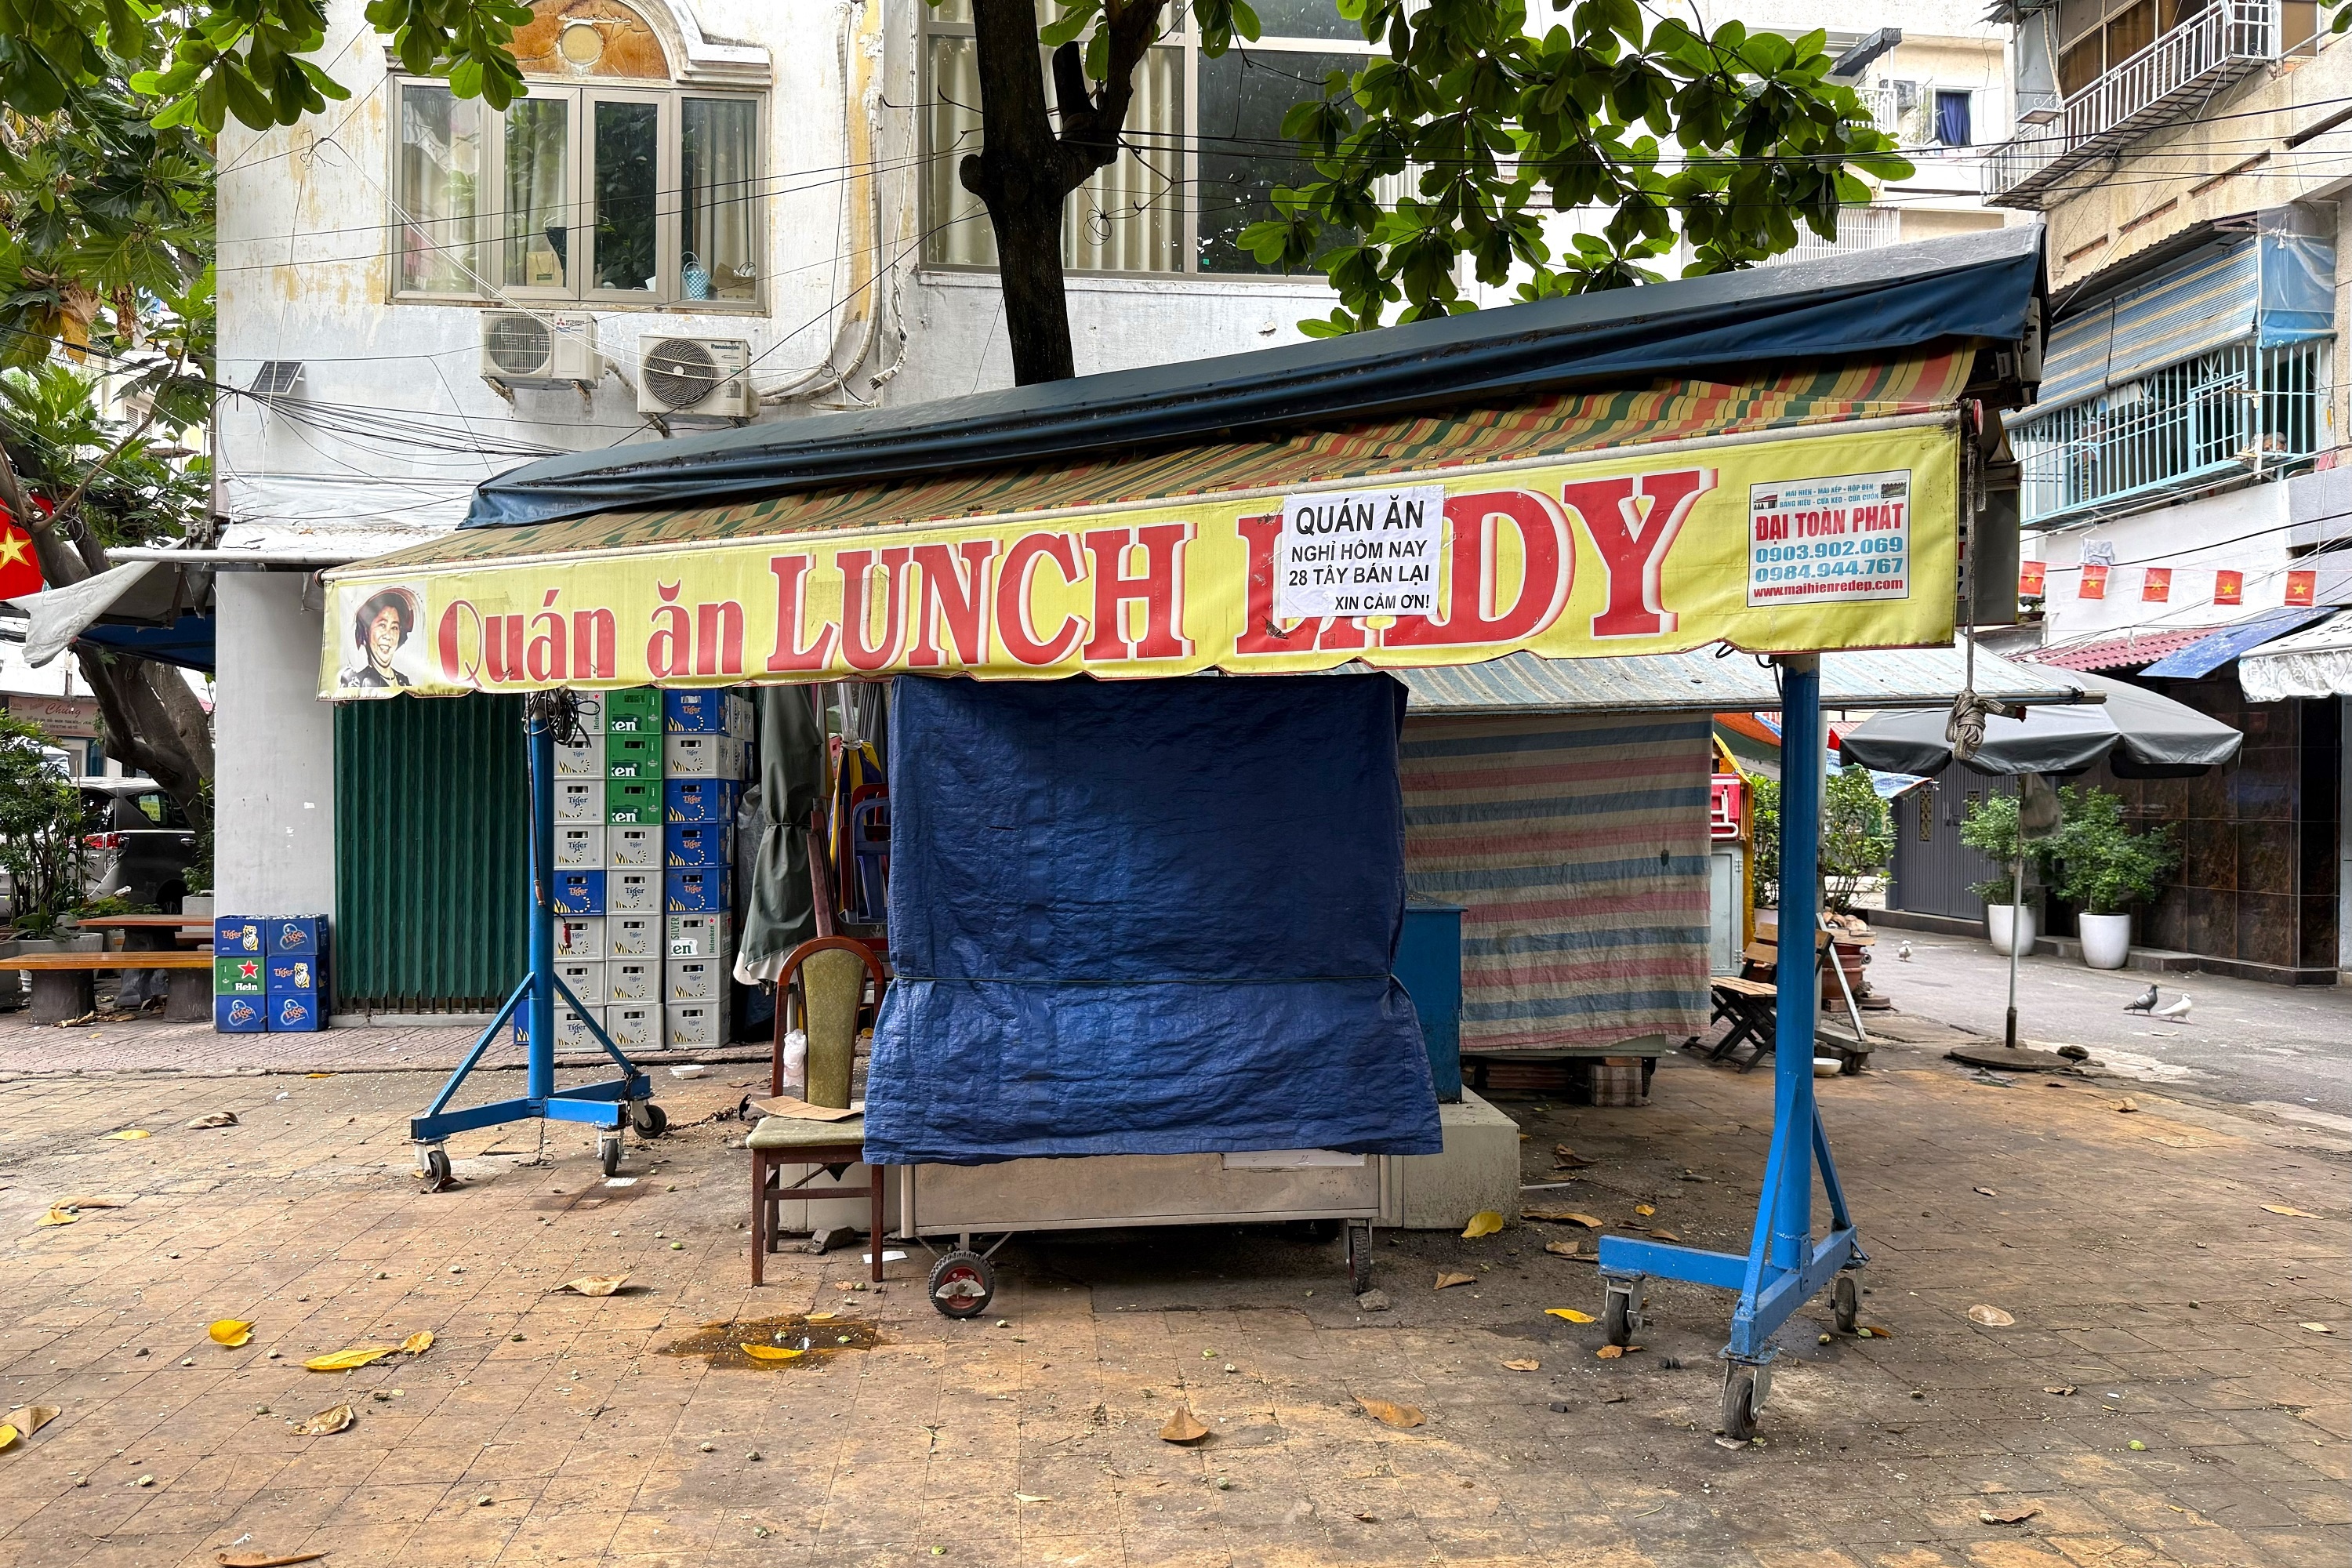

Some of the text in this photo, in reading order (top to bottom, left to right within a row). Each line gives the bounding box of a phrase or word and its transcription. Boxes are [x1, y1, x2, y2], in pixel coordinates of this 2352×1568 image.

[1296, 495, 1424, 536] QUÁN ĂN
[1755, 500, 1904, 545] ĐẠI TOÀN PHÁT
[1291, 539, 1428, 562] NGHỈ HÔM NAY
[1755, 536, 1903, 564] 0903.902.069
[1289, 563, 1429, 586] 28 TÂY BÁN LẠI
[1755, 557, 1904, 582] 0984.944.767
[437, 588, 618, 688] Quán
[646, 579, 745, 679] ăn
[765, 521, 1200, 672] LUNCH
[1233, 468, 1719, 656] LDY
[1754, 579, 1904, 597] www.maihienredep.com
[1335, 592, 1430, 610] XIN CẢM ƠN!
[682, 706, 702, 715] Tiger
[568, 796, 588, 808] Tiger
[683, 795, 702, 804] Tiger
[567, 840, 588, 853] Tiger
[683, 840, 702, 849] Tiger
[568, 887, 588, 897] Tiger
[625, 887, 644, 898] Tiger
[684, 884, 703, 894] Tiger
[671, 916, 680, 939] SILVER
[221, 930, 242, 939] Tiger
[671, 945, 692, 955] en
[274, 967, 294, 978] Tiger
[235, 982, 258, 991] Hein
[567, 1023, 587, 1035] Tiger
